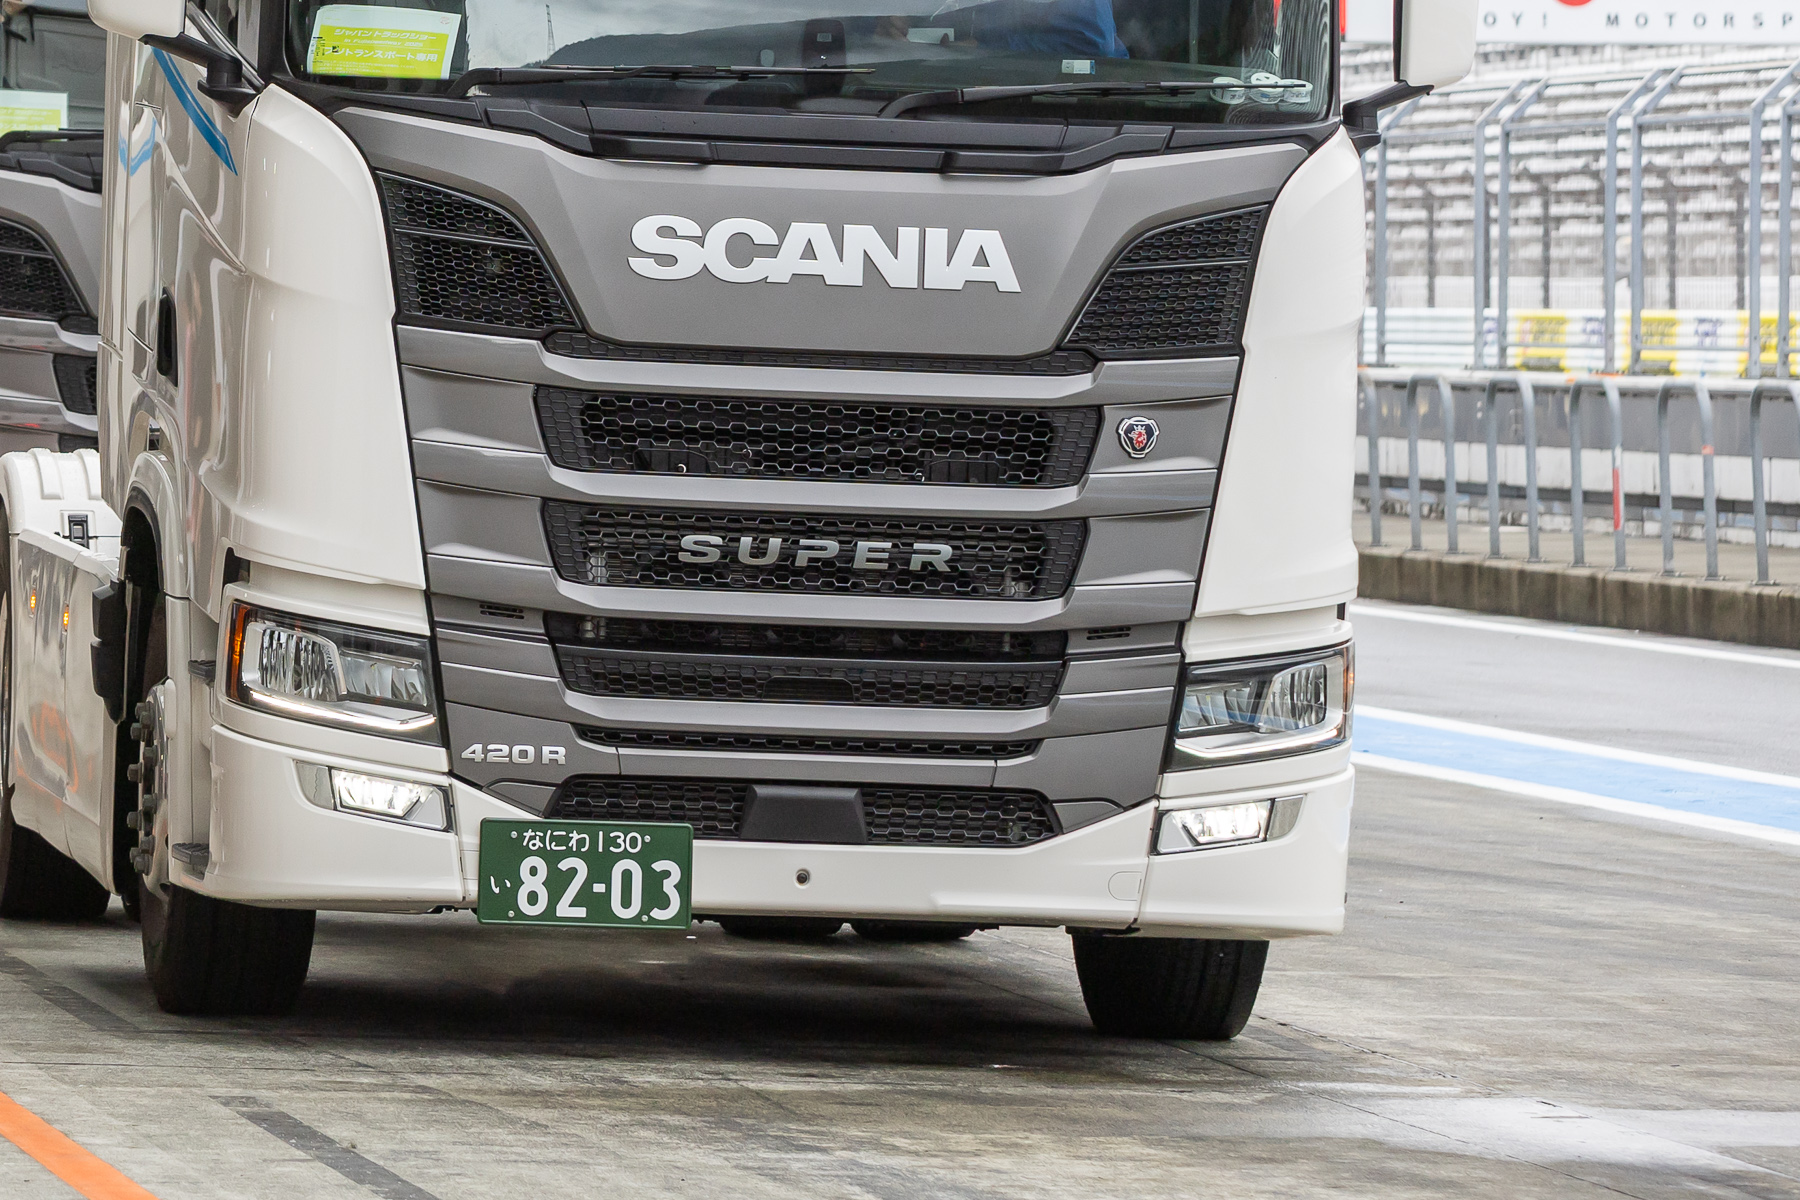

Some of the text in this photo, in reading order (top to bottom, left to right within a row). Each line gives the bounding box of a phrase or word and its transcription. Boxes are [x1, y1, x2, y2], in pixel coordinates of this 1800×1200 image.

[1484, 12, 1793, 28] OY! MOTORSP
[627, 214, 1022, 294] SCANIA
[677, 533, 954, 573] SUPER
[460, 743, 567, 765] 420 R
[522, 828, 643, 854] なにわ 130
[489, 855, 682, 921] い 82-03
